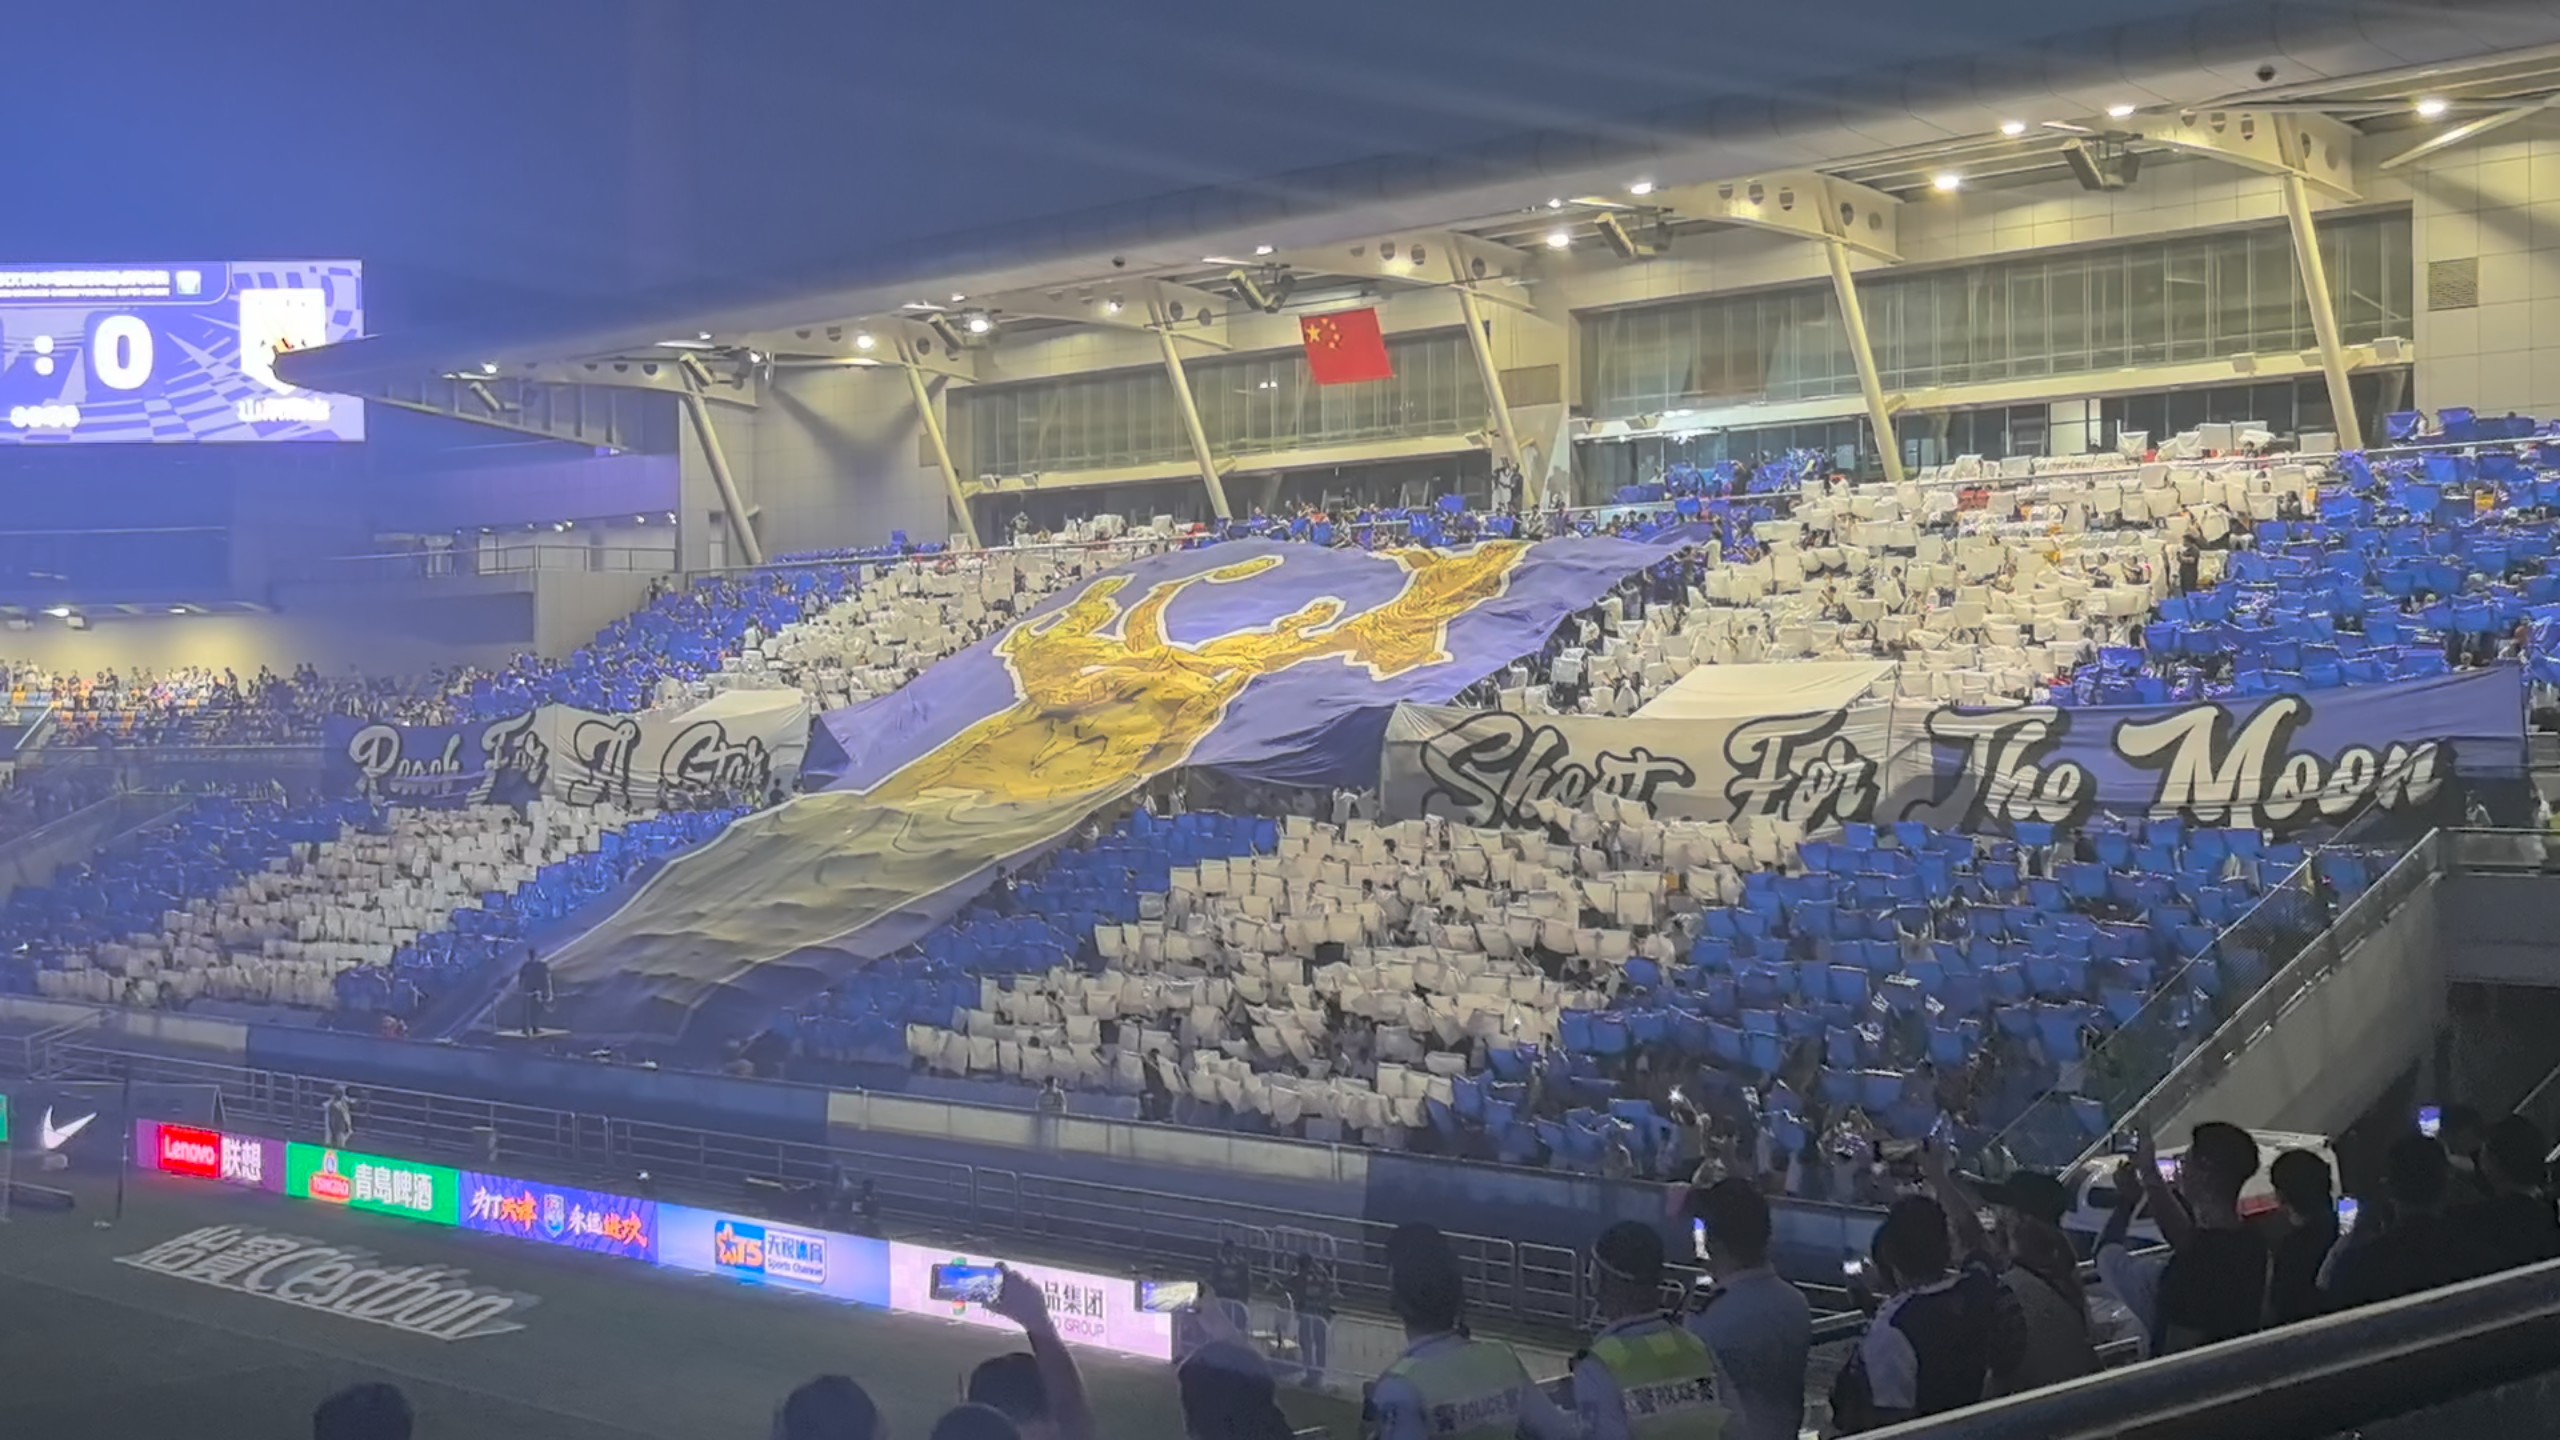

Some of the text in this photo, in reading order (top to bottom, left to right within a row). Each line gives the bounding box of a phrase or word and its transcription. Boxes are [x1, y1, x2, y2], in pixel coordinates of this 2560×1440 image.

[93, 314, 154, 391] 0
[1420, 693, 2452, 834] Shoot For The Moon
[163, 1134, 216, 1166] Lenovo
[222, 1137, 262, 1181] 联想
[767, 1257, 791, 1271] Sports
[1064, 1317, 1105, 1337] GROUP
